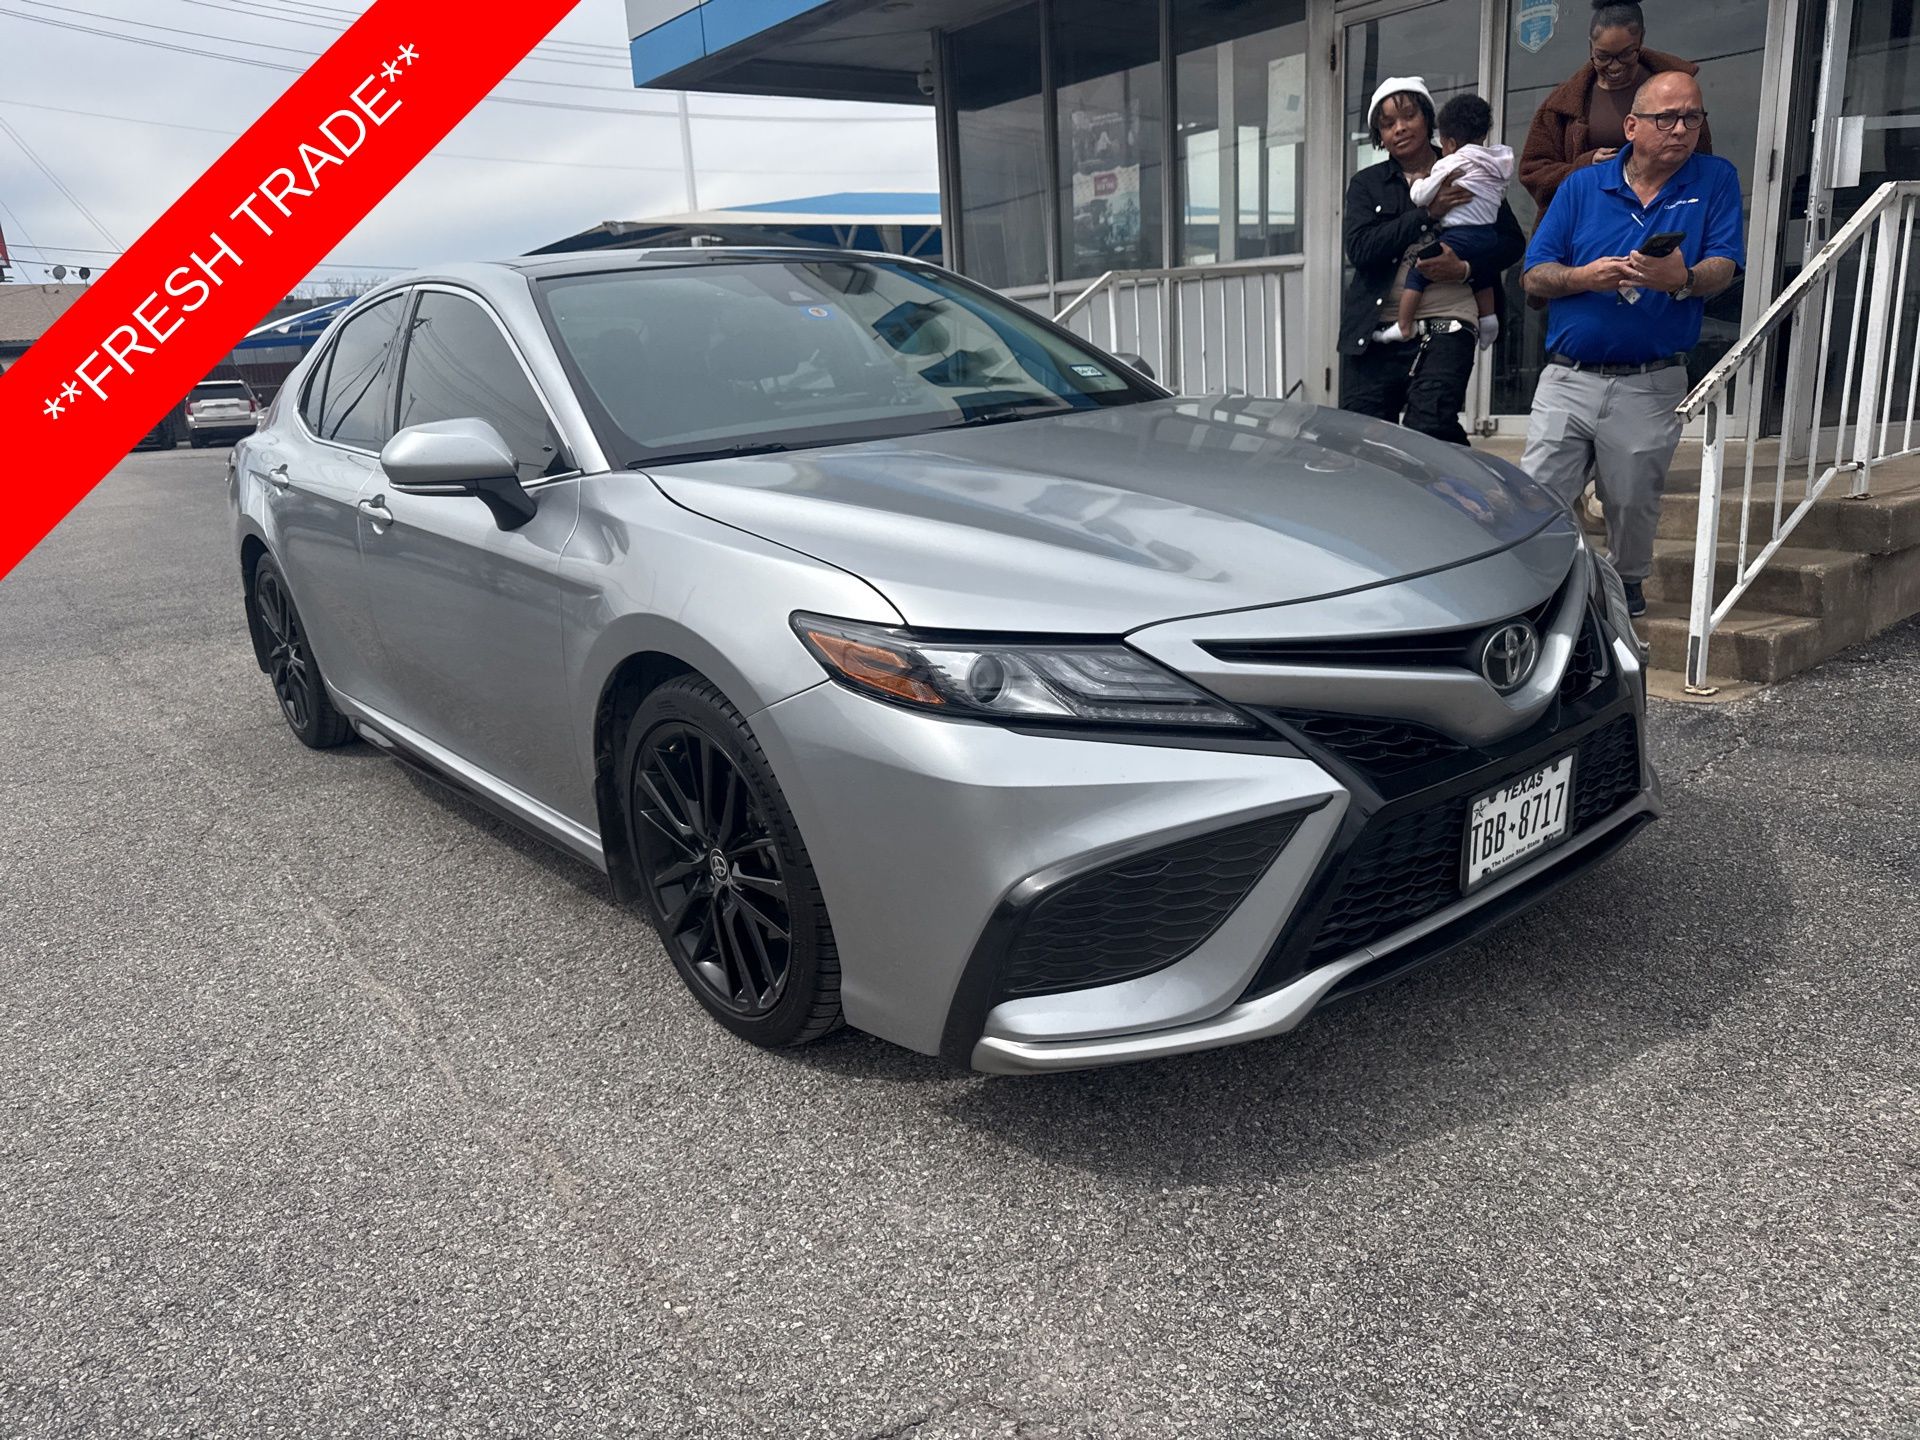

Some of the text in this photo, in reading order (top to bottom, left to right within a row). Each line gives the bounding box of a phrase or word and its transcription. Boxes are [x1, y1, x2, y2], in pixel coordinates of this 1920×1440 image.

[1504, 770, 1544, 803] TEXAS
[1491, 839, 1540, 868] The Lone Star State
